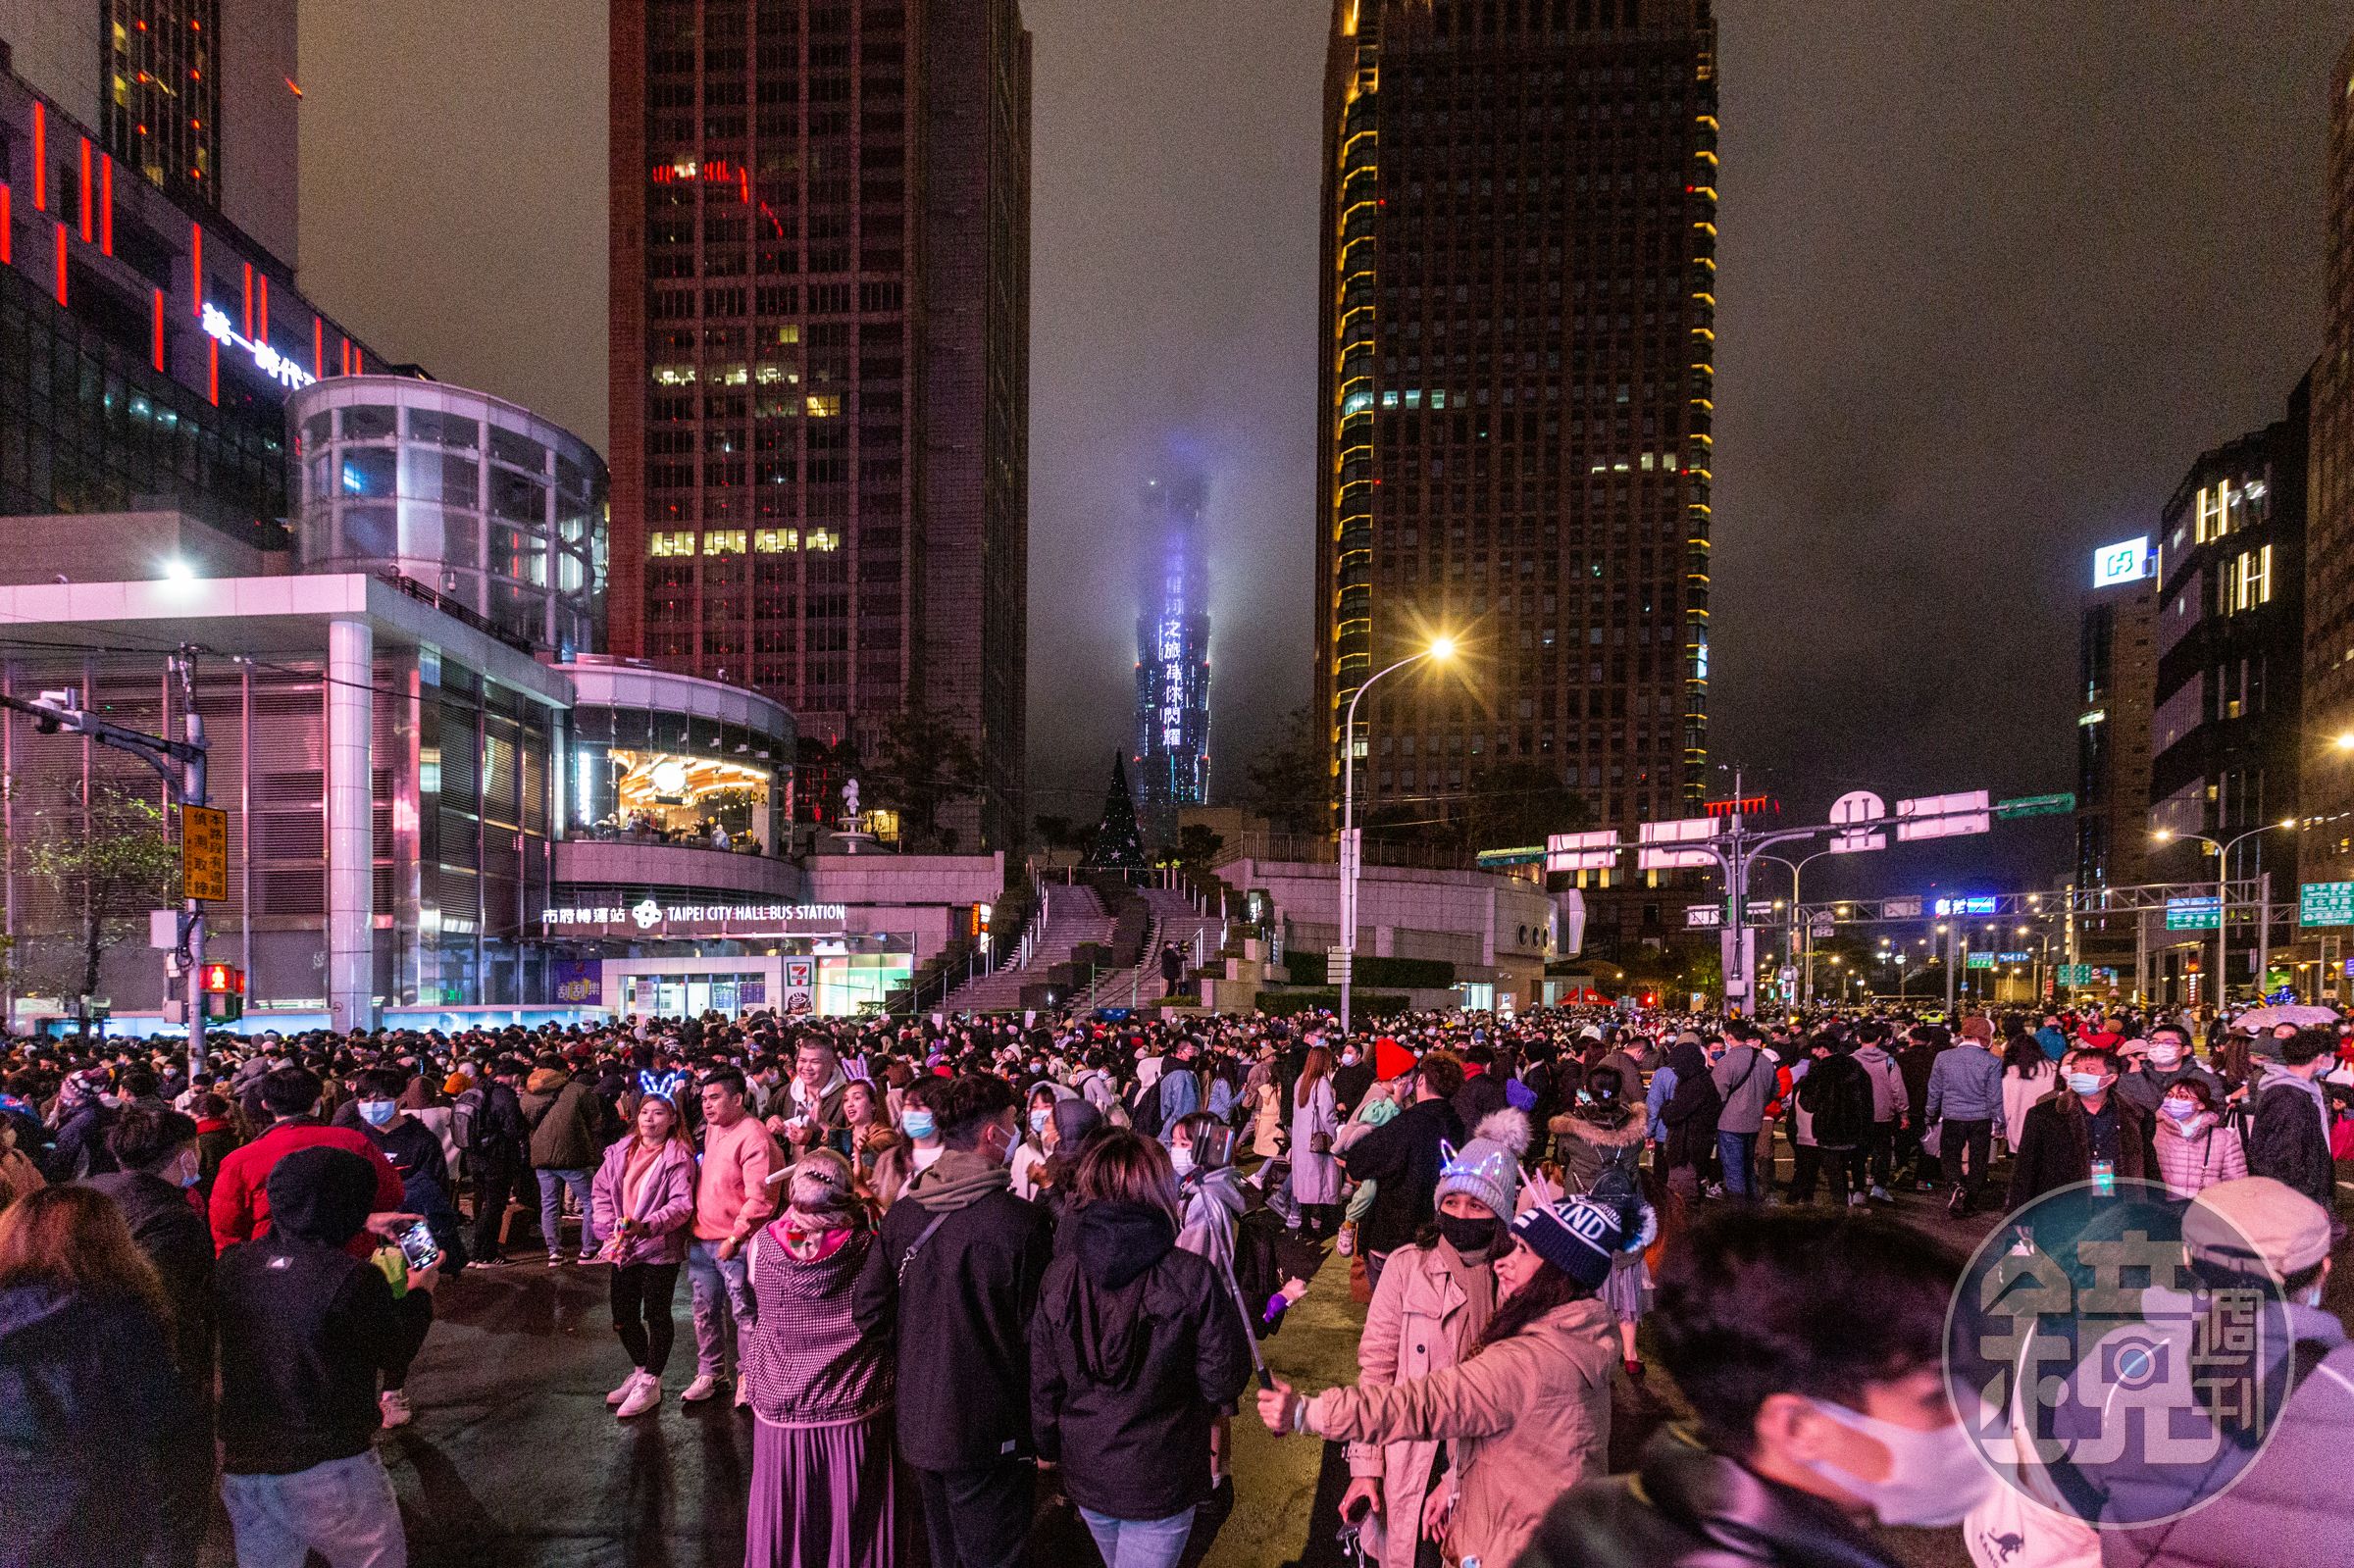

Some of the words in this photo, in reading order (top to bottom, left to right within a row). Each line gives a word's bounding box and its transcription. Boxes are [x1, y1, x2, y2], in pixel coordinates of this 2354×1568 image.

[542, 908, 626, 924] 市府轉運站
[667, 906, 704, 922] TAIPEI
[707, 906, 733, 921] CITY
[736, 906, 767, 921] HALL
[769, 905, 793, 920] BUS
[795, 904, 845, 920] STATION
[557, 982, 600, 999] 刮刮樂
